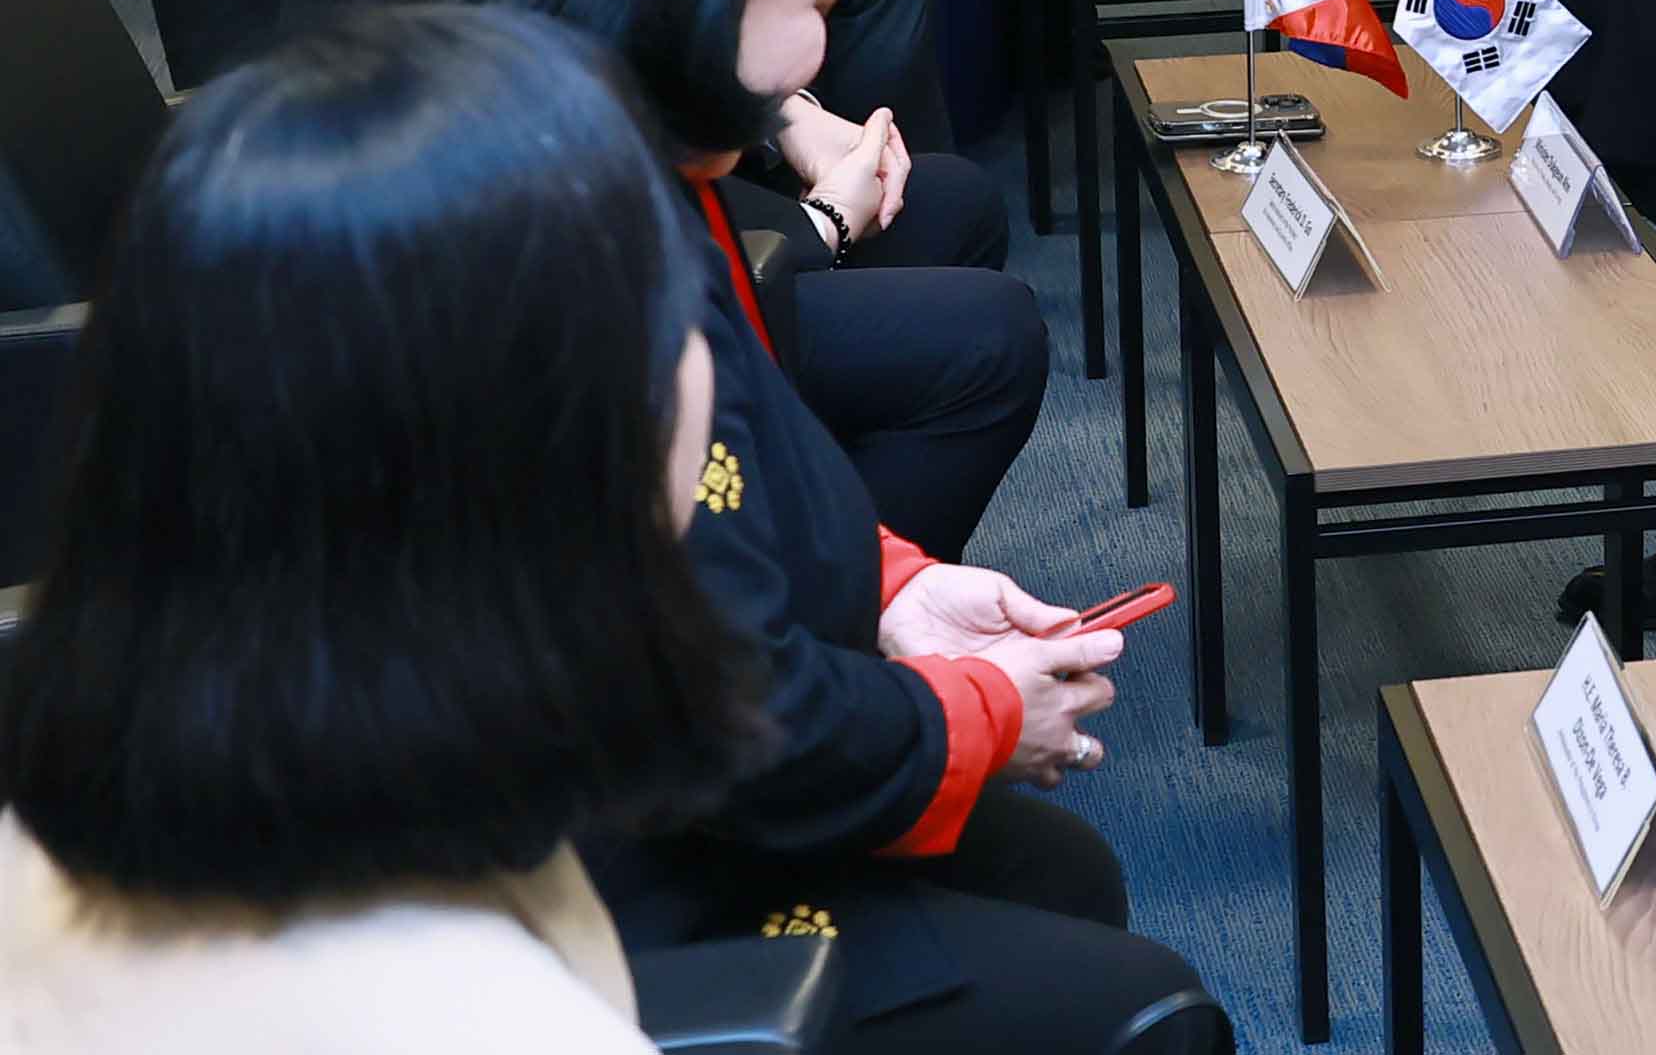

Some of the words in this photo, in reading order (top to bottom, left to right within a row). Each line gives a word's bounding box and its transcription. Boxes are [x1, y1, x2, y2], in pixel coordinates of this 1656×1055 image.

[1592, 695, 1607, 733] Maria
[1604, 725, 1625, 776] Theresa
[1592, 764, 1608, 800] Vega
